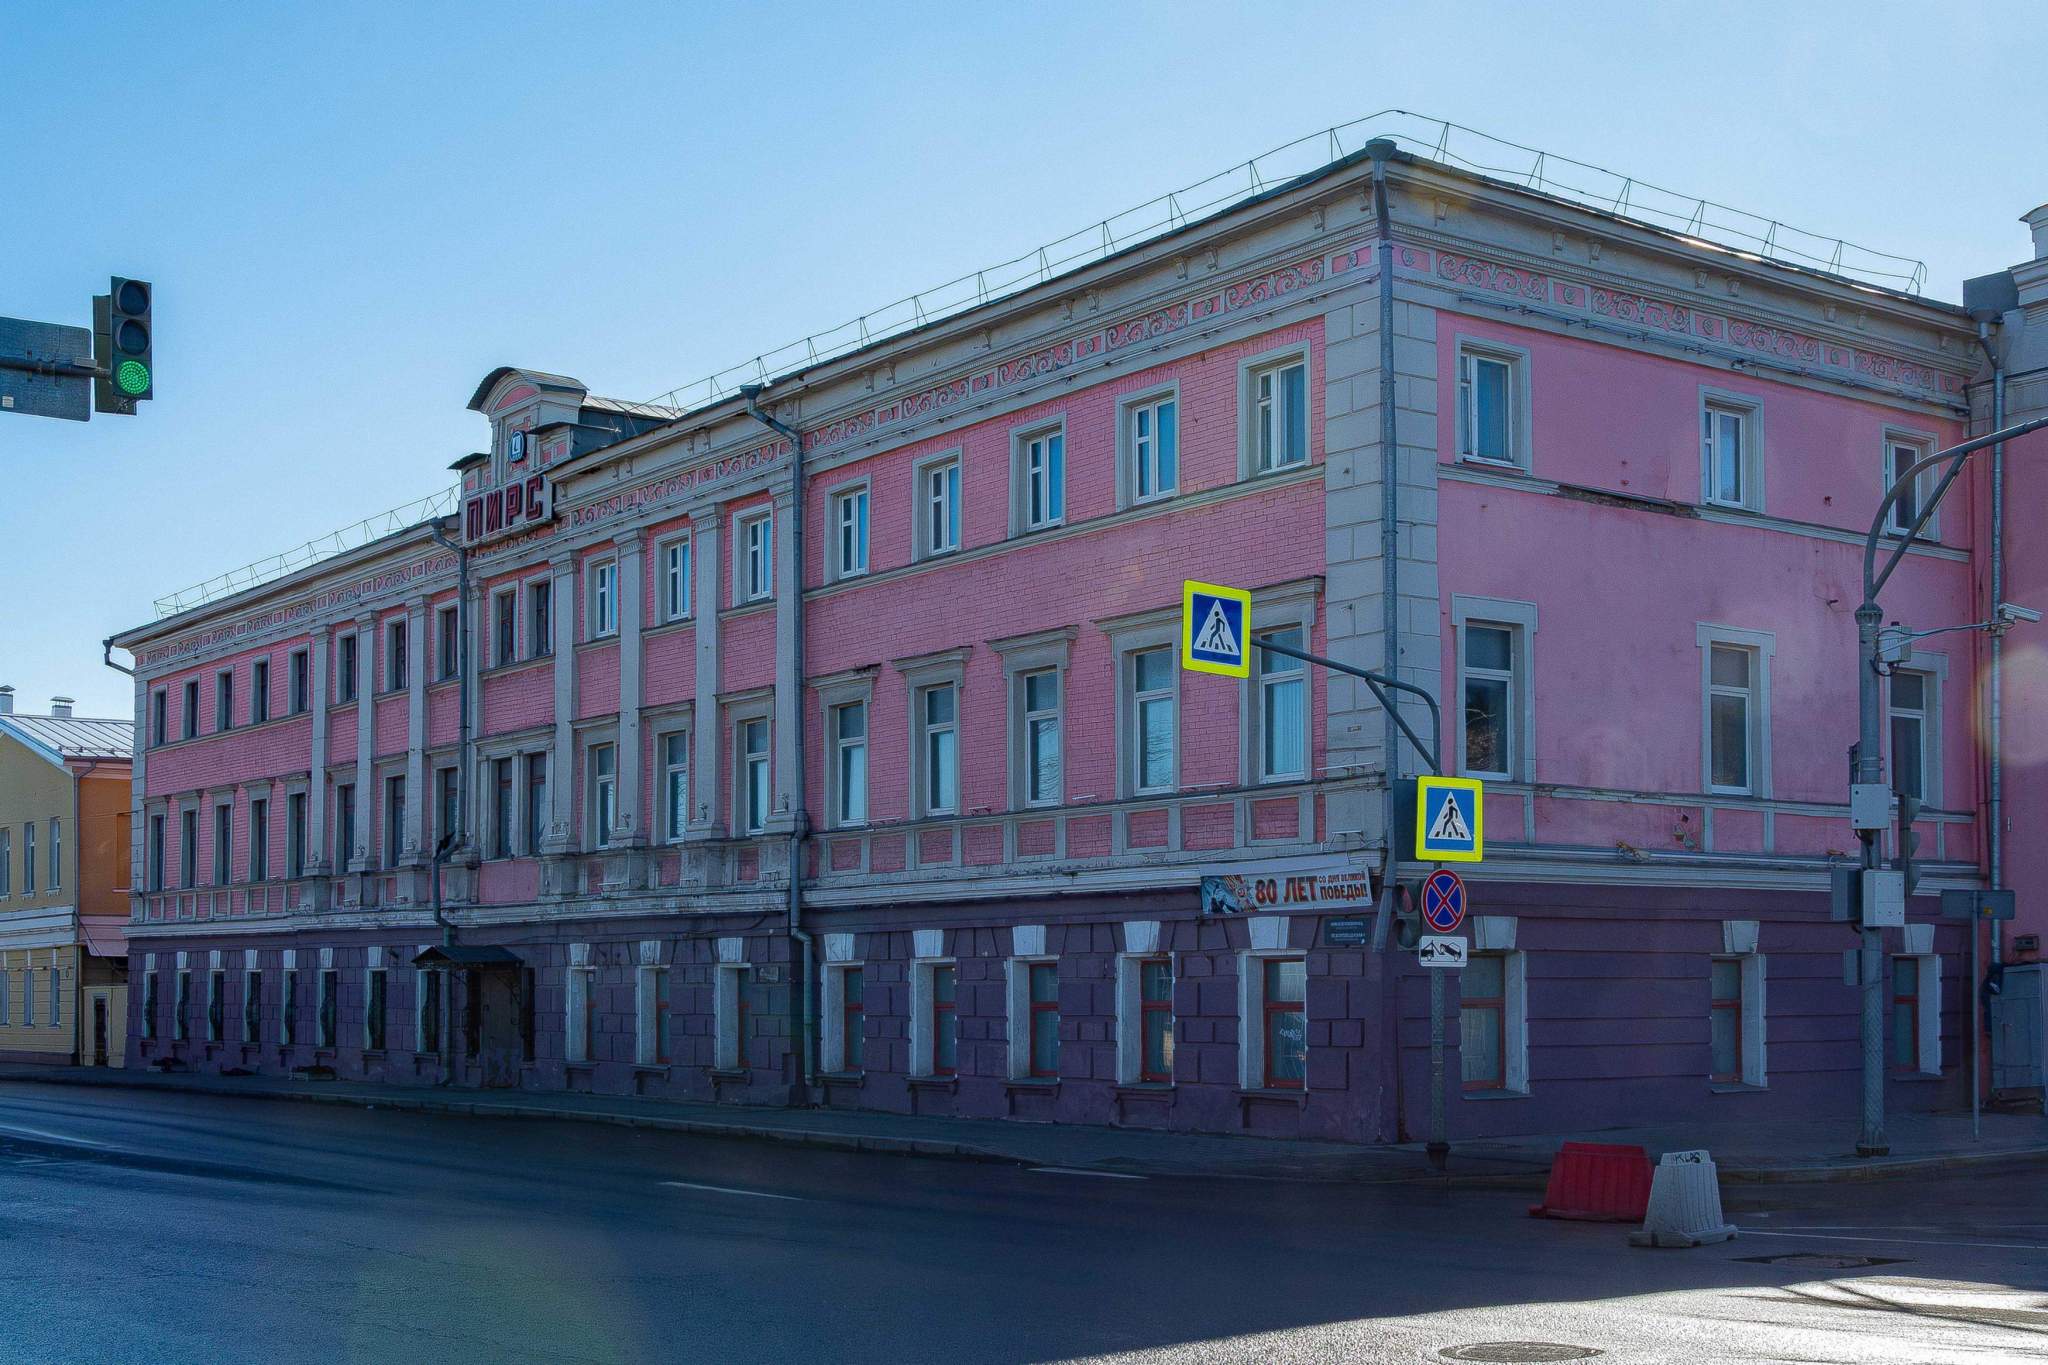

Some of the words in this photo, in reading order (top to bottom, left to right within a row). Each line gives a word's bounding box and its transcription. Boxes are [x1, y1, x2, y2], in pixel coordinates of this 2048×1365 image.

[467, 476, 543, 542] ПИРС
[1256, 879, 1277, 904] 80
[1283, 876, 1317, 902] ЛЕТ
[1320, 883, 1367, 901] ПОБЕДЫ!
